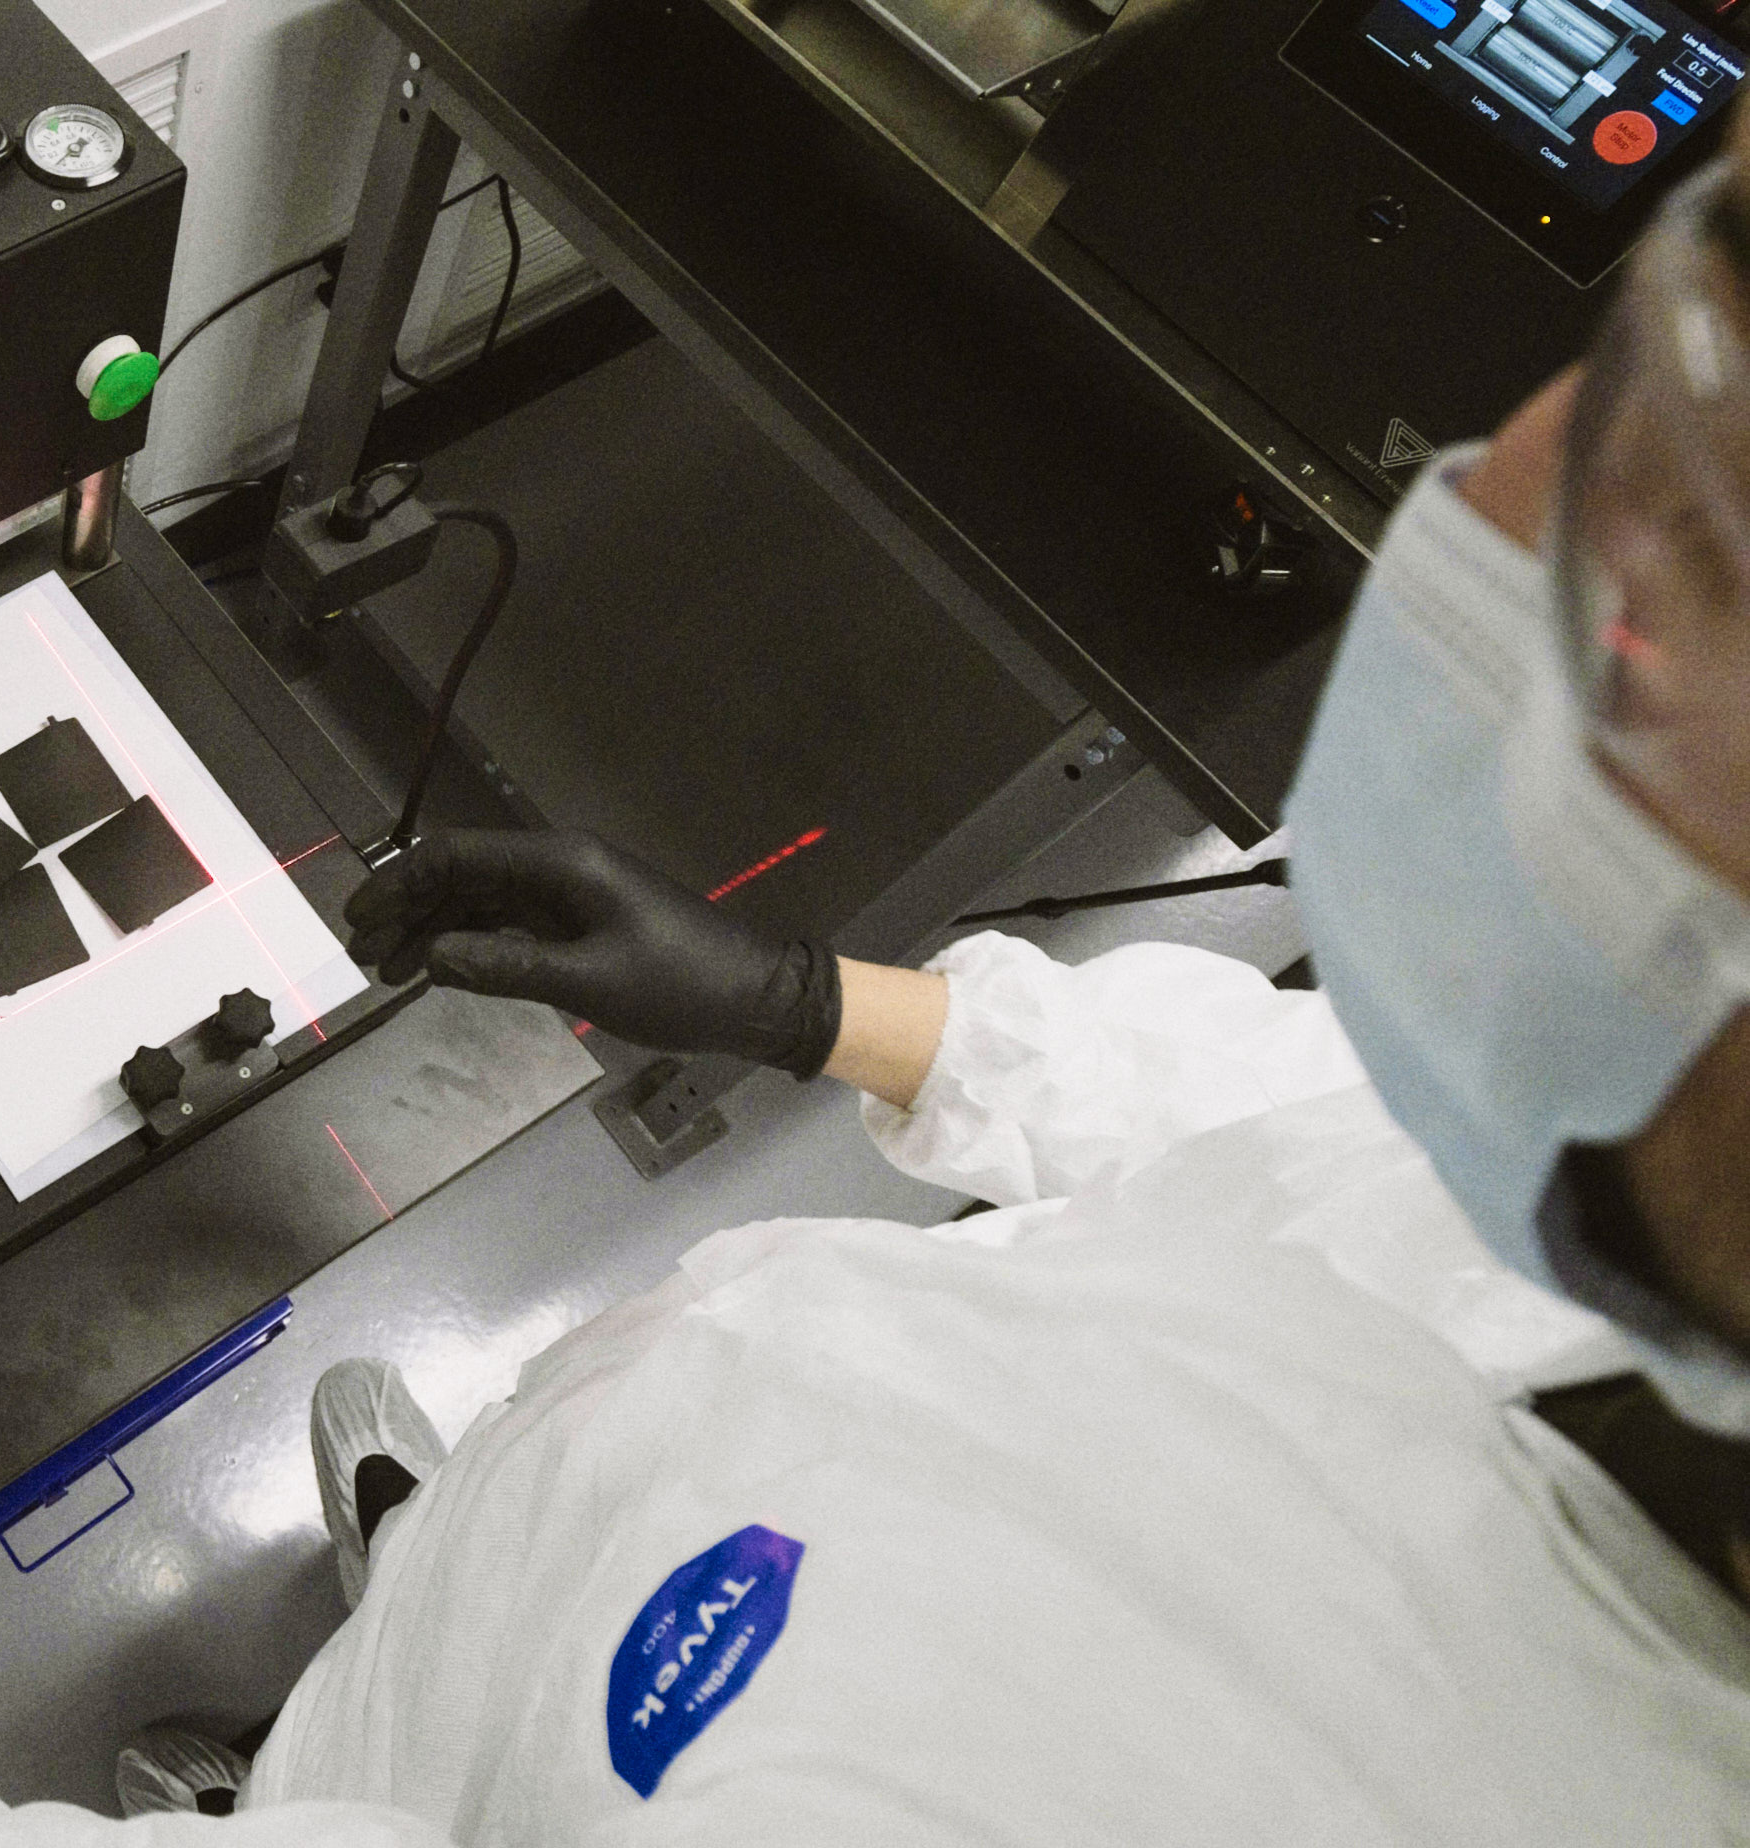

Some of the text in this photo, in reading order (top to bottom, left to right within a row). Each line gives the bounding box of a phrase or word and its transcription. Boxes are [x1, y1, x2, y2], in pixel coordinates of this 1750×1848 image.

[1681, 33, 1699, 48] Line
[1696, 43, 1722, 62] Speed
[1410, 50, 1433, 70] Home
[1688, 60, 1708, 77] 0.5
[1656, 68, 1704, 104] Feed Direction
[1471, 95, 1501, 121] Logging
[1664, 99, 1685, 116] FWD
[1609, 132, 1630, 151] Stop
[1615, 122, 1643, 143] Motor
[1539, 146, 1569, 169] Control
[642, 1609, 677, 1655] 400
[632, 1576, 758, 1730] Tyvek
